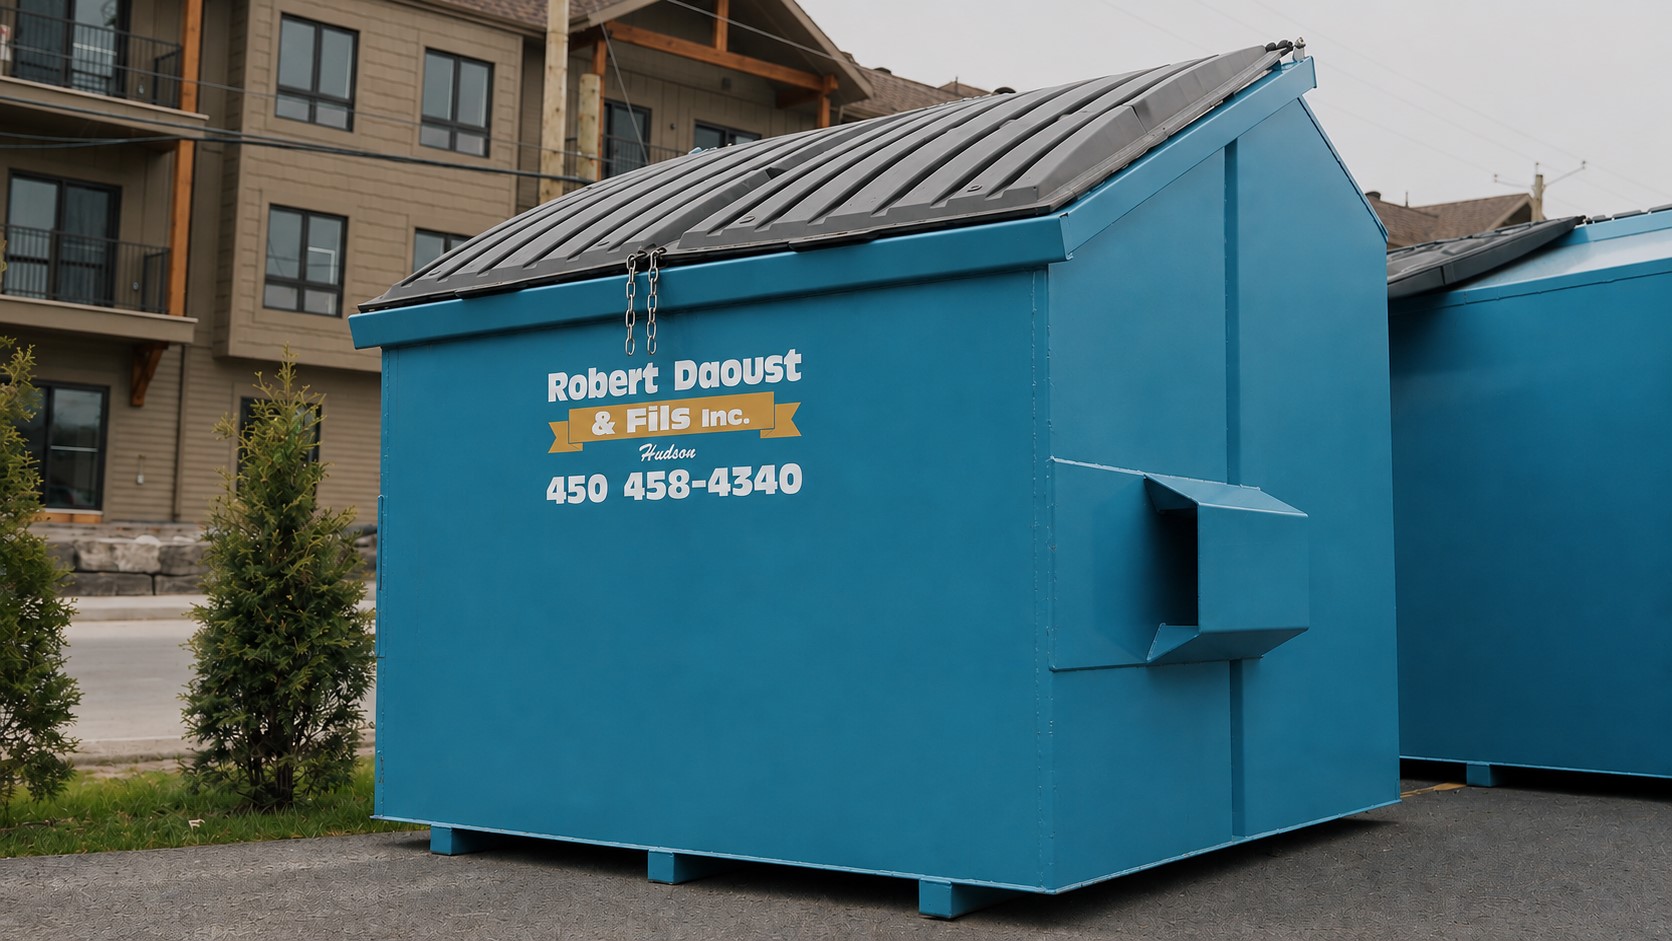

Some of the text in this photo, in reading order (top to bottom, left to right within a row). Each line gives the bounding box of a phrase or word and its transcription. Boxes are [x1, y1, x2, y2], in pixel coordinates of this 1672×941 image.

[547, 348, 802, 403] Robert Daoust
[591, 405, 750, 436] & Fils Inc.
[638, 443, 697, 462] Hudson
[546, 462, 803, 505] 450 458-4340
